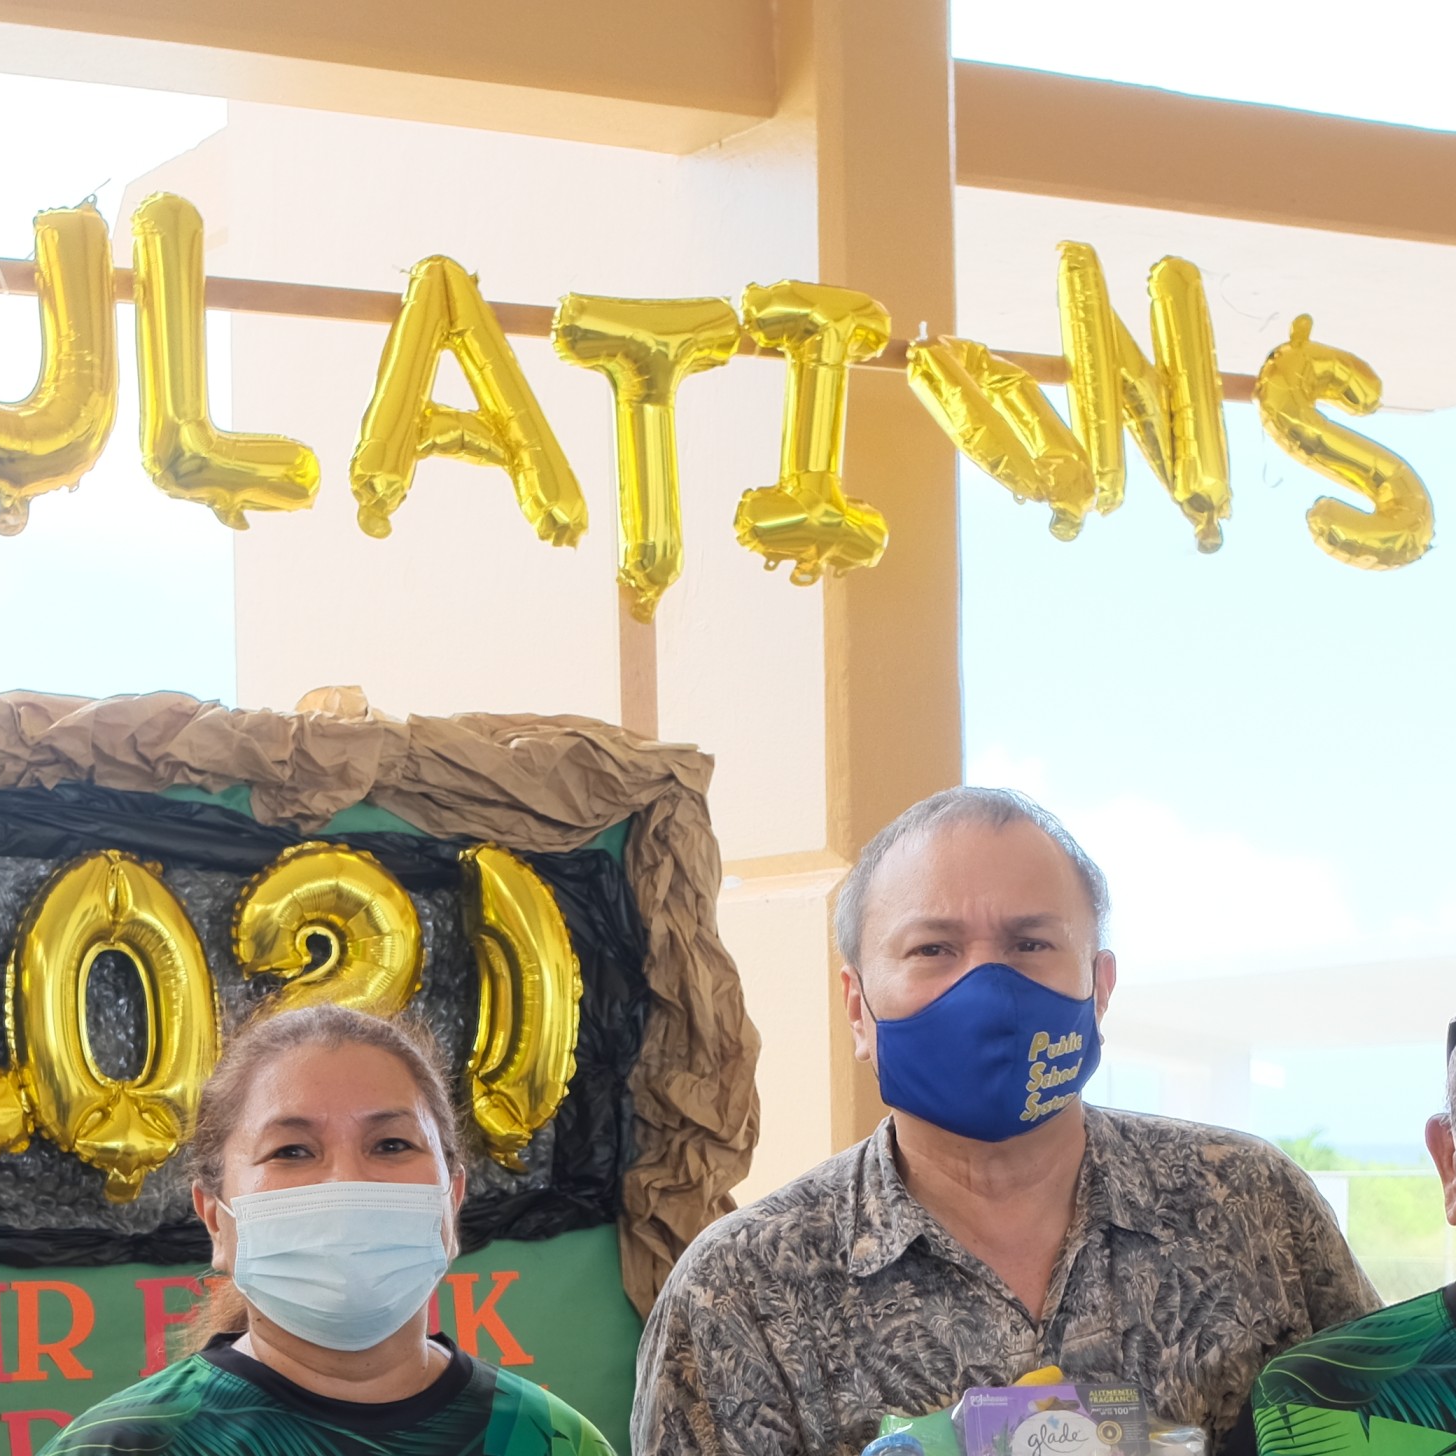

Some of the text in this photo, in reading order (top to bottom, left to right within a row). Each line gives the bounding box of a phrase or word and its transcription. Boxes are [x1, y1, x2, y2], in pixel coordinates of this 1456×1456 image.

[1028, 1031, 1083, 1062] Public
[1025, 1058, 1084, 1092] School
[1113, 1407, 1129, 1415] 100
